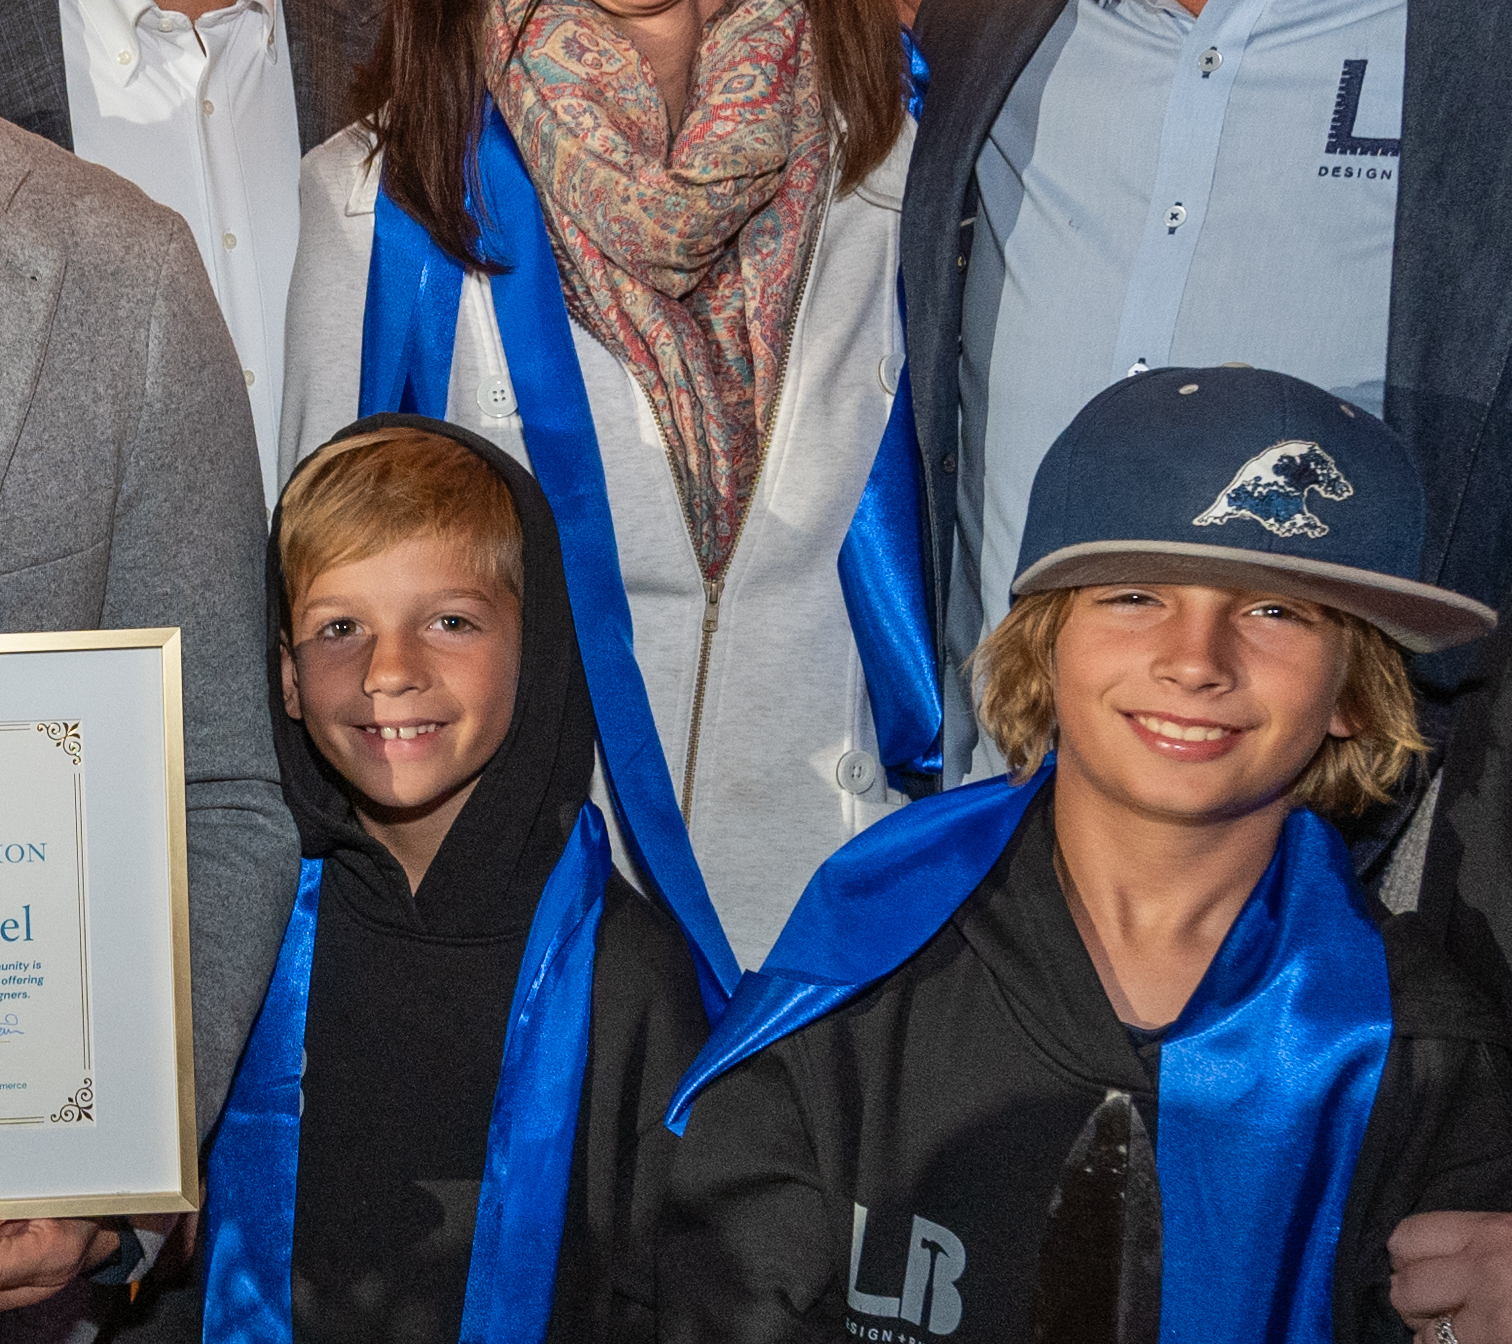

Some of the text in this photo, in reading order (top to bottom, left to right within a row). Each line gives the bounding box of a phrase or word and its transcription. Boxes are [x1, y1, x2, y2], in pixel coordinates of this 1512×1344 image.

[1317, 166, 1393, 180] DESIGN
[32, 960, 42, 970] is
[1, 975, 44, 987] offering
